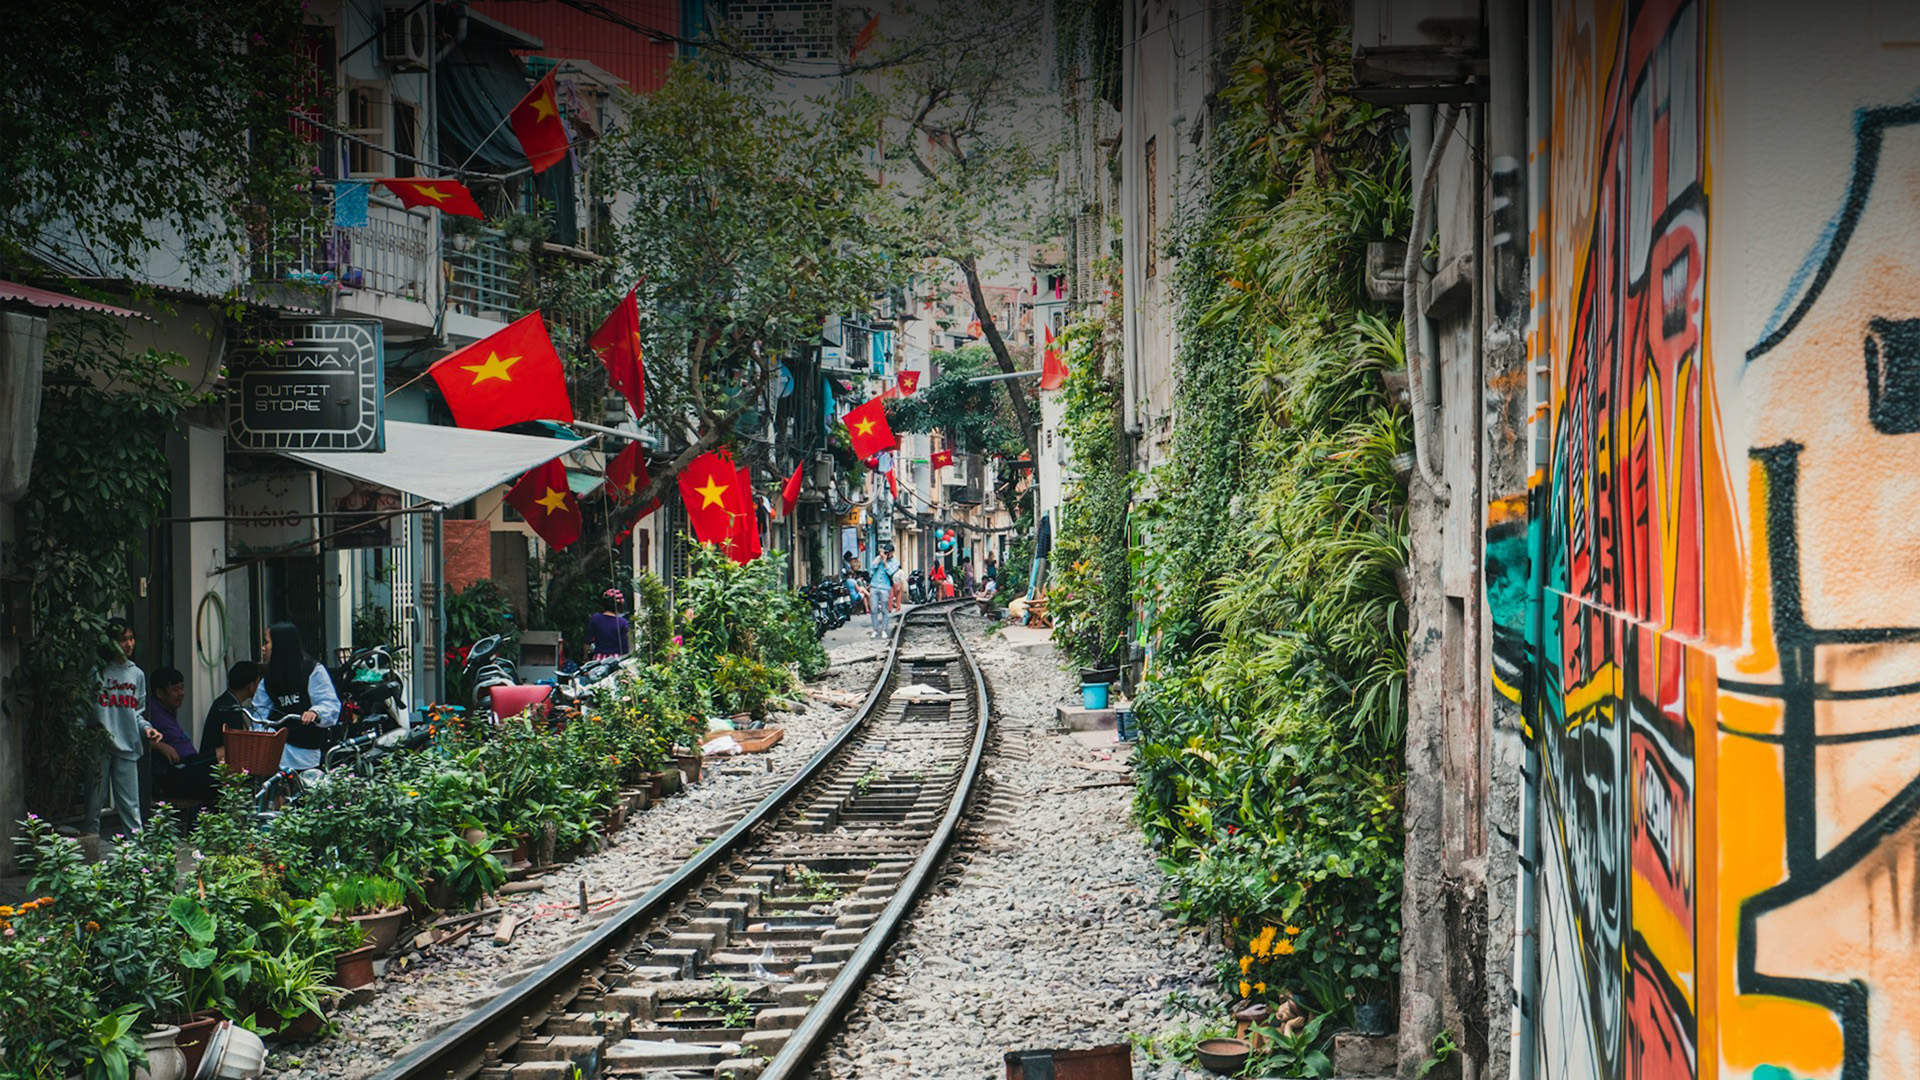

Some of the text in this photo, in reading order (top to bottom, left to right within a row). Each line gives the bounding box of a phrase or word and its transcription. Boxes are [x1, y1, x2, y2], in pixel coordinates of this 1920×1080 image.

[232, 354, 357, 367] RAILWAY
[255, 385, 331, 396] OUTFIT
[255, 400, 321, 411] STORE
